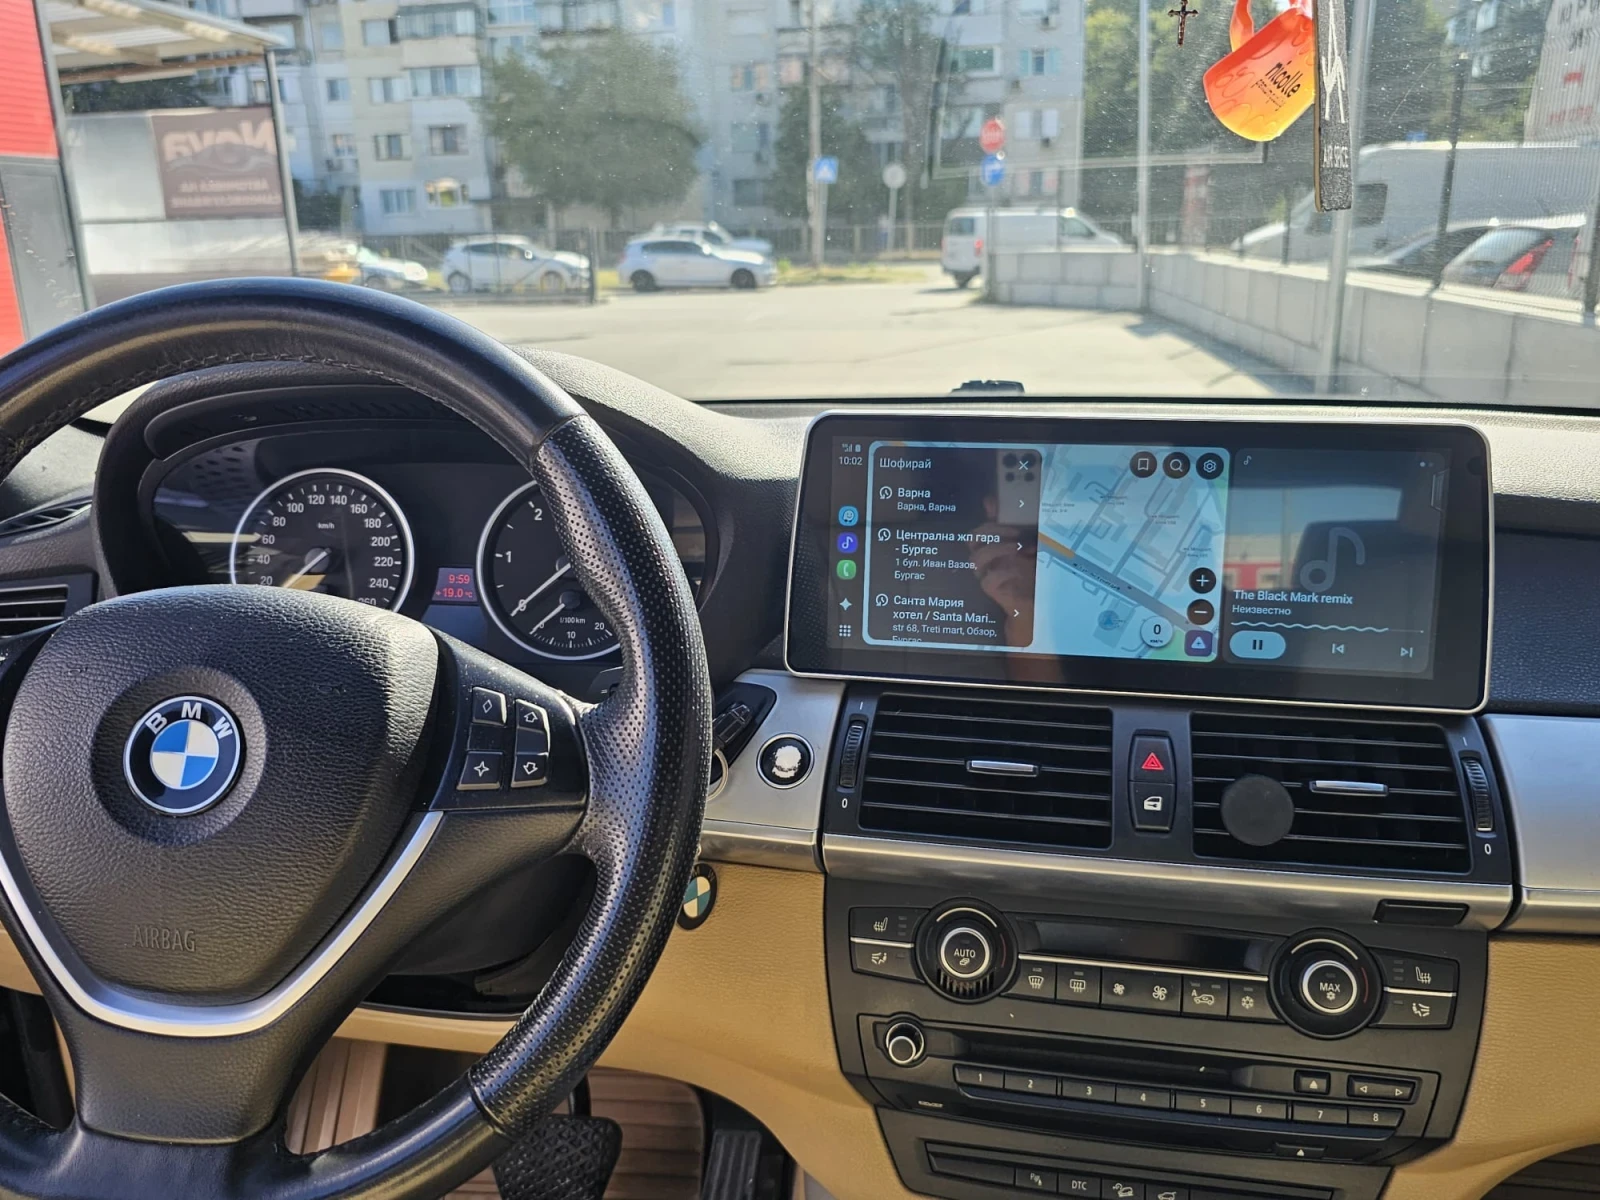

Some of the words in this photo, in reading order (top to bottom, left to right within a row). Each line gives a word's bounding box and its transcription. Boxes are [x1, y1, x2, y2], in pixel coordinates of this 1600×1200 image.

[1265, 60, 1303, 98] nicolle
[838, 456, 863, 465] 10:02
[879, 457, 932, 469] Шофирай
[897, 488, 931, 499] Варна
[308, 495, 325, 505] 120
[330, 495, 347, 505] 140
[287, 503, 304, 513] 100
[351, 504, 368, 514] 160
[897, 502, 927, 512] Варна,
[928, 503, 957, 513] Варна
[534, 508, 543, 521] 2
[272, 516, 286, 527] 80
[364, 518, 381, 529] 180
[262, 534, 275, 545] 60
[371, 536, 390, 547] 200
[896, 530, 955, 542] Централна
[957, 533, 973, 544] жп
[976, 534, 1000, 544] гара
[901, 544, 938, 556] Бургас
[256, 554, 270, 564] 40
[374, 556, 394, 567] 220
[902, 558, 921, 569] бул.
[923, 559, 946, 569] Иван
[948, 560, 978, 571] Вазов,
[260, 576, 273, 586] 20
[448, 574, 470, 584] 9:59
[894, 571, 925, 582] Бургас
[369, 578, 389, 588] 240
[894, 596, 926, 606] Санта
[928, 597, 964, 608] Мария
[1233, 589, 1255, 600] The
[1257, 590, 1288, 602] Black
[1290, 592, 1319, 603] Mark
[1321, 593, 1353, 605] remix
[893, 611, 923, 620] хотел
[932, 610, 963, 622] Santa
[1232, 605, 1292, 616] Неизвестно
[576, 616, 586, 624] km
[594, 622, 605, 631] 20
[892, 624, 904, 632] str
[906, 624, 920, 634] 68,
[921, 624, 941, 634] Treti
[942, 626, 965, 636] mart,
[966, 627, 998, 638] Обзор,
[1153, 623, 1162, 635] 0
[567, 631, 576, 639] 10
[145, 701, 233, 740] BMW
[132, 925, 197, 953] AIRBAG
[953, 948, 976, 958] AUTO
[1319, 982, 1341, 993] MAX
[1028, 1079, 1034, 1089] 2
[1086, 1086, 1093, 1095] 3
[1140, 1092, 1147, 1102] 4
[1200, 1099, 1206, 1108] 5
[1256, 1105, 1262, 1114] 6
[1318, 1110, 1324, 1119] 7
[1373, 1113, 1379, 1122] 8
[1071, 1180, 1088, 1191] DTC
